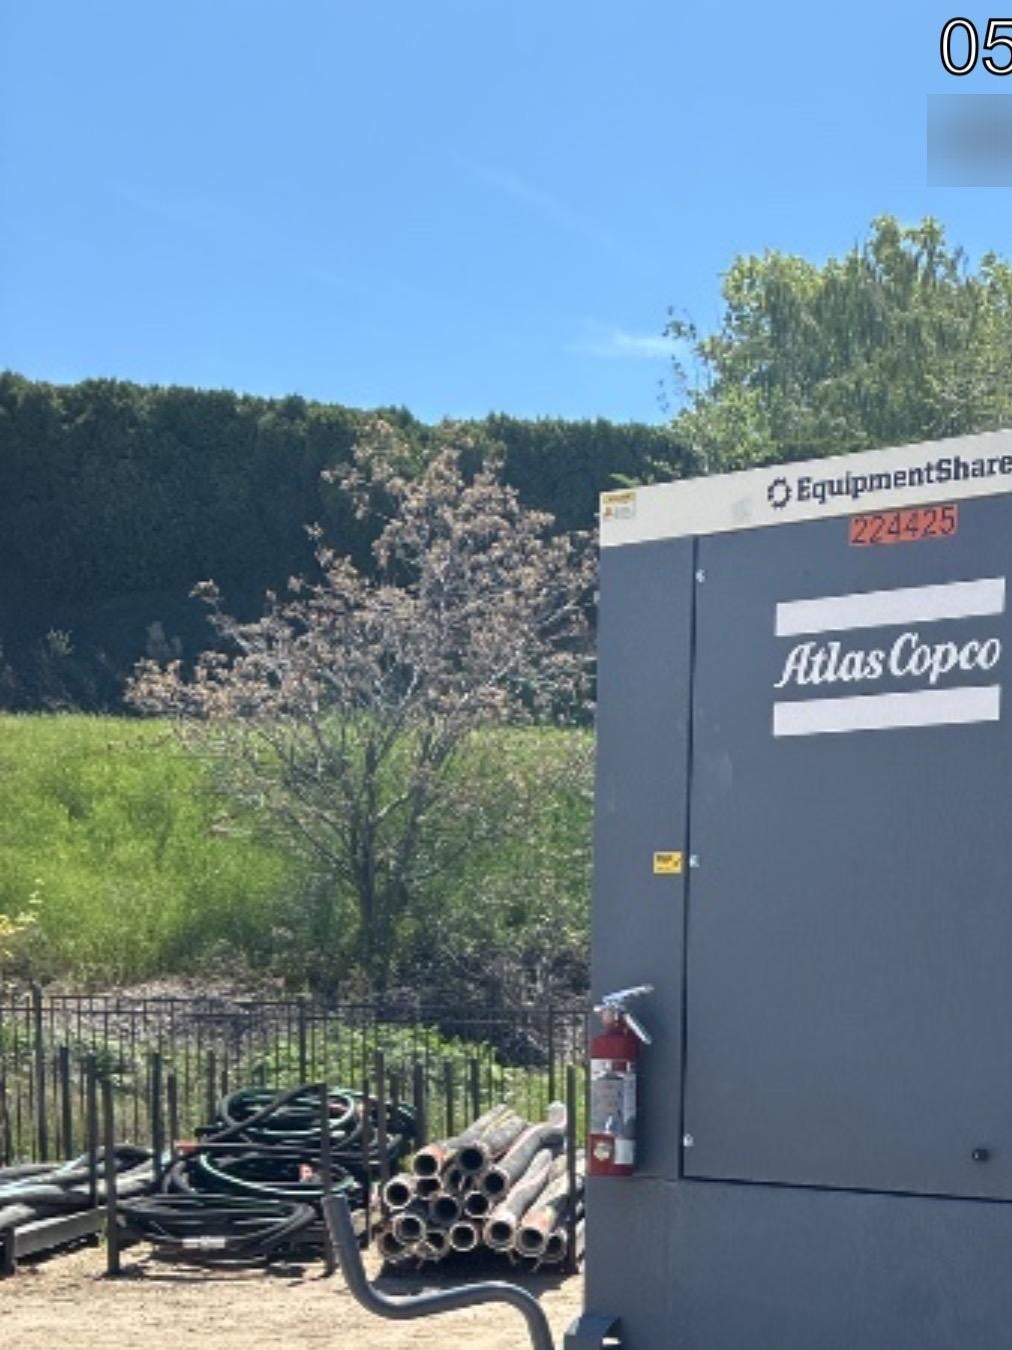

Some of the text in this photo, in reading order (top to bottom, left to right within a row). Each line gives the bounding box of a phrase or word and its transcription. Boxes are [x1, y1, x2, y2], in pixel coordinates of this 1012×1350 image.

[850, 506, 956, 544] 224425
[773, 631, 1002, 688] Atlas Copco
